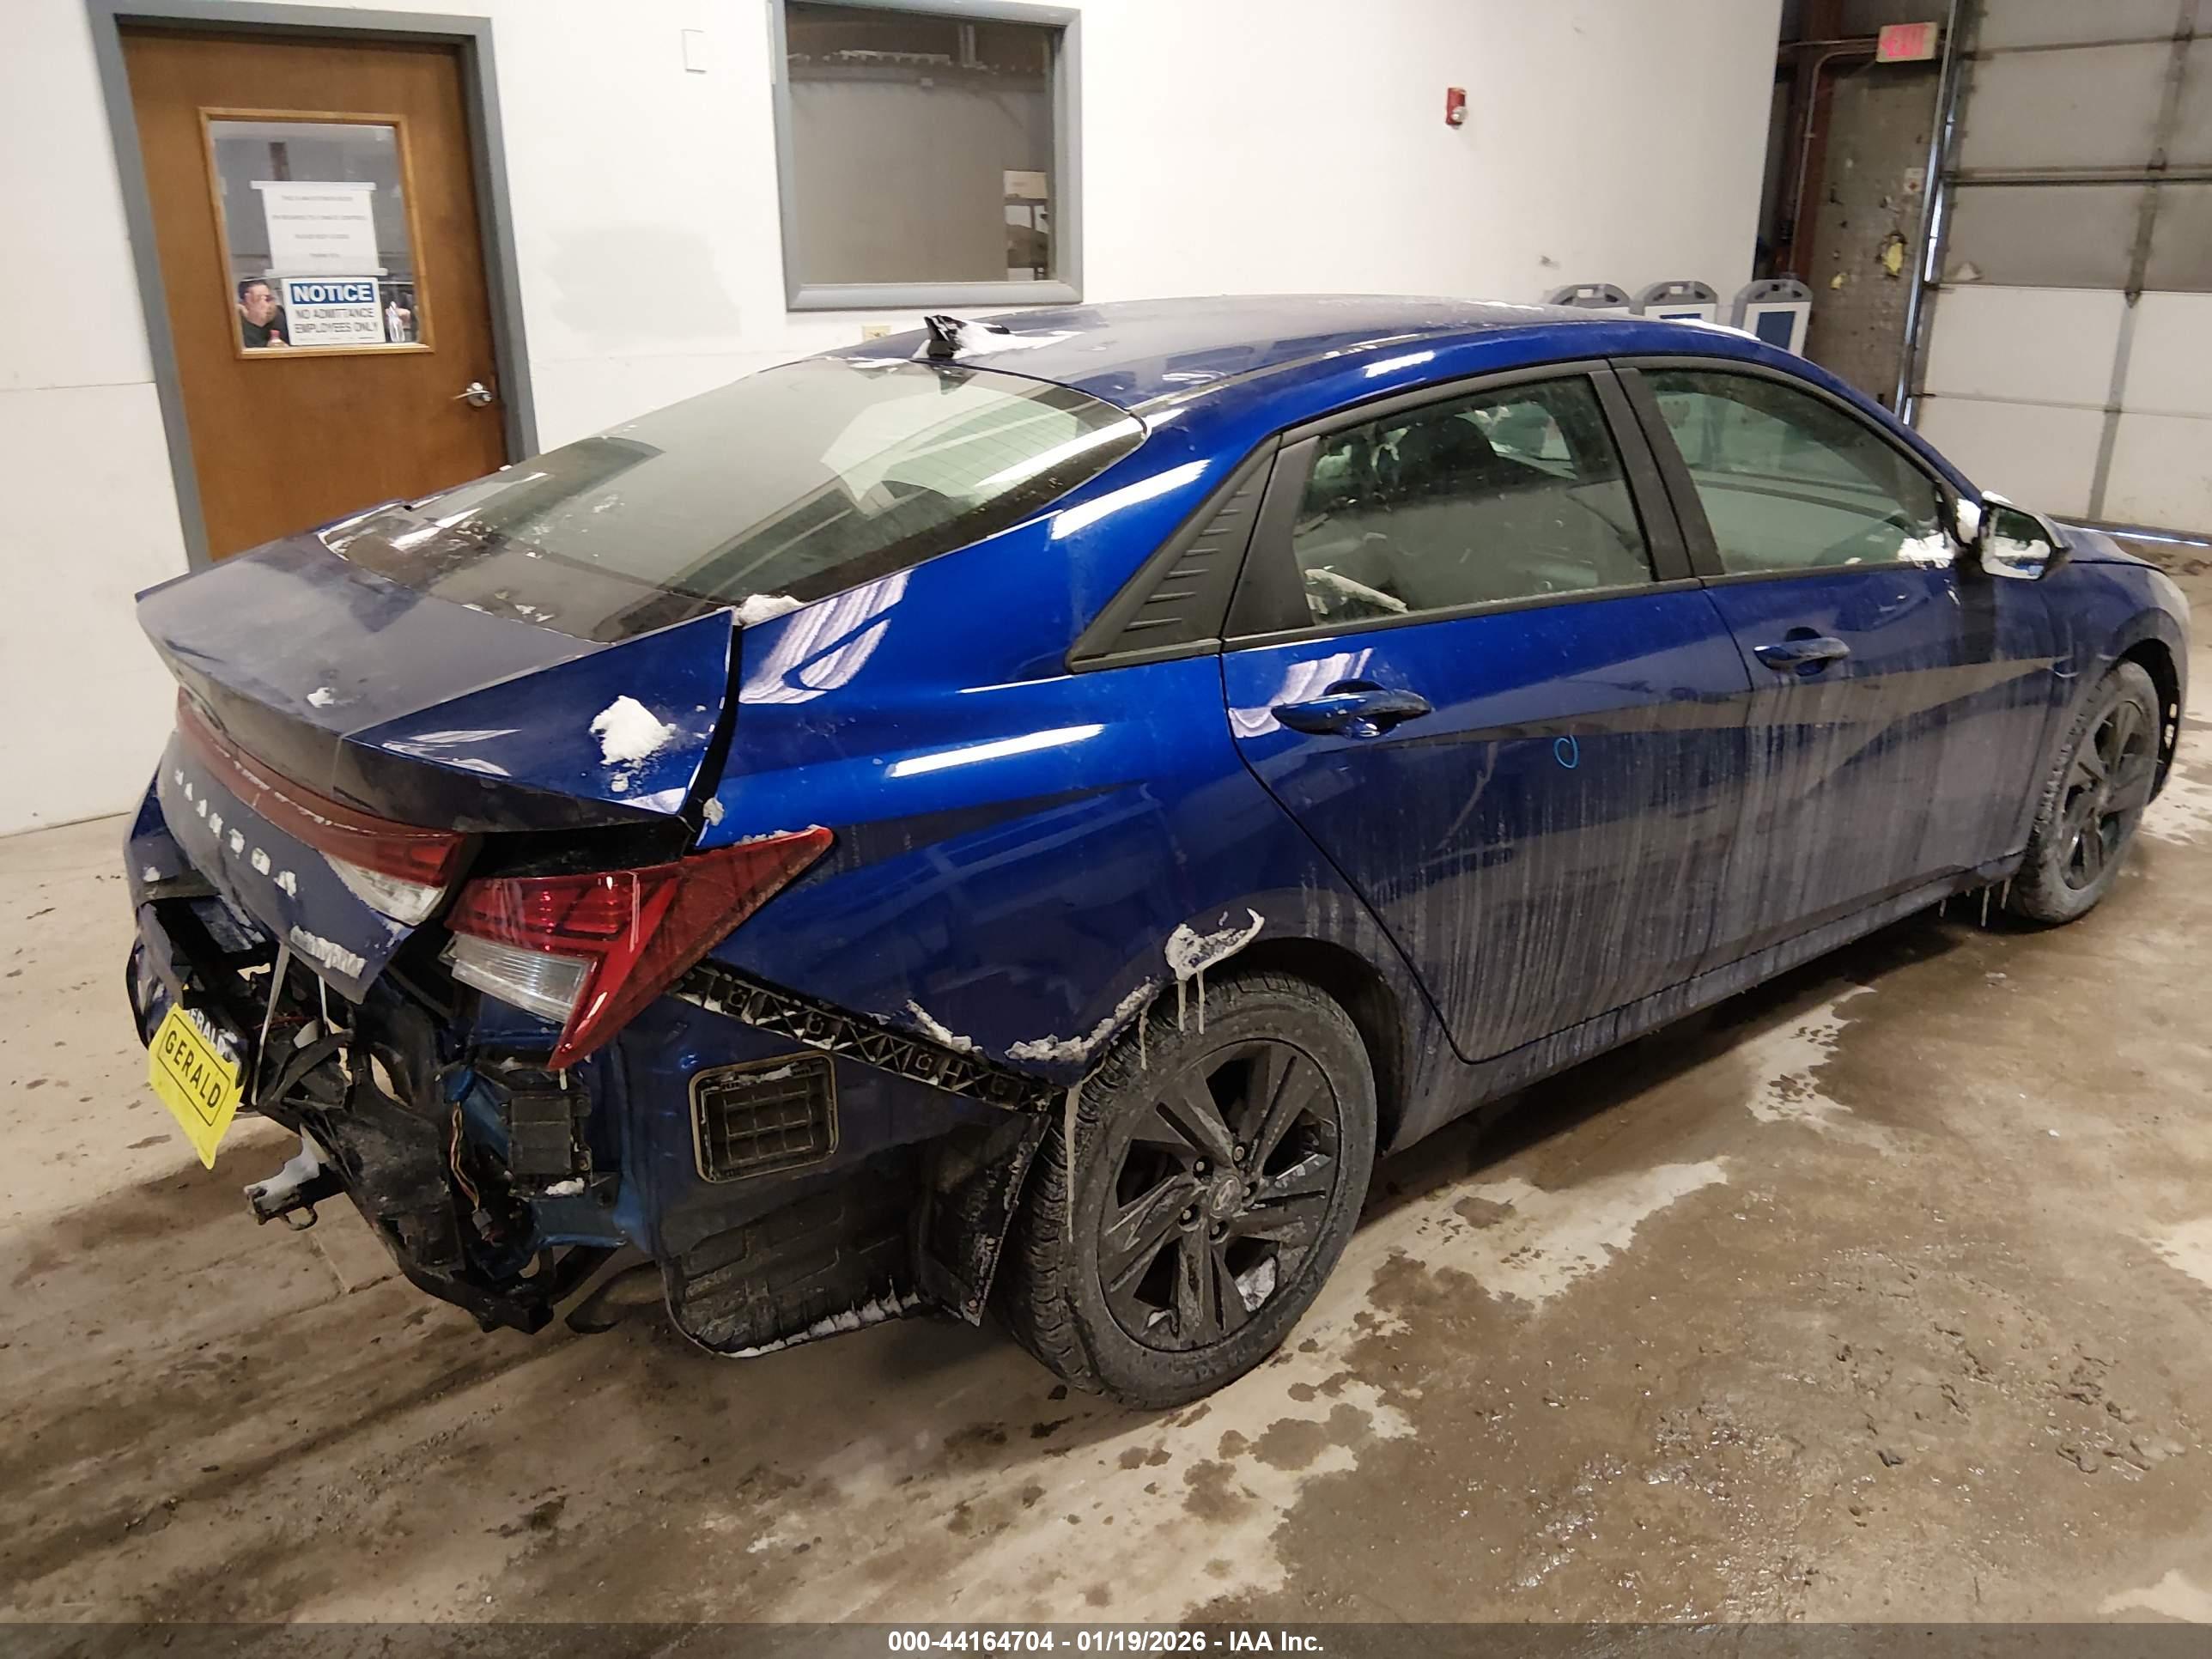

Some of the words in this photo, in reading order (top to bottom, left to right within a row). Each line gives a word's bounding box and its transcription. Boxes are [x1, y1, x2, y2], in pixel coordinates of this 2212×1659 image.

[293, 284, 373, 302] NOTICE
[295, 322, 351, 333] EMPLOYEES
[165, 1030, 222, 1109] GERALD
